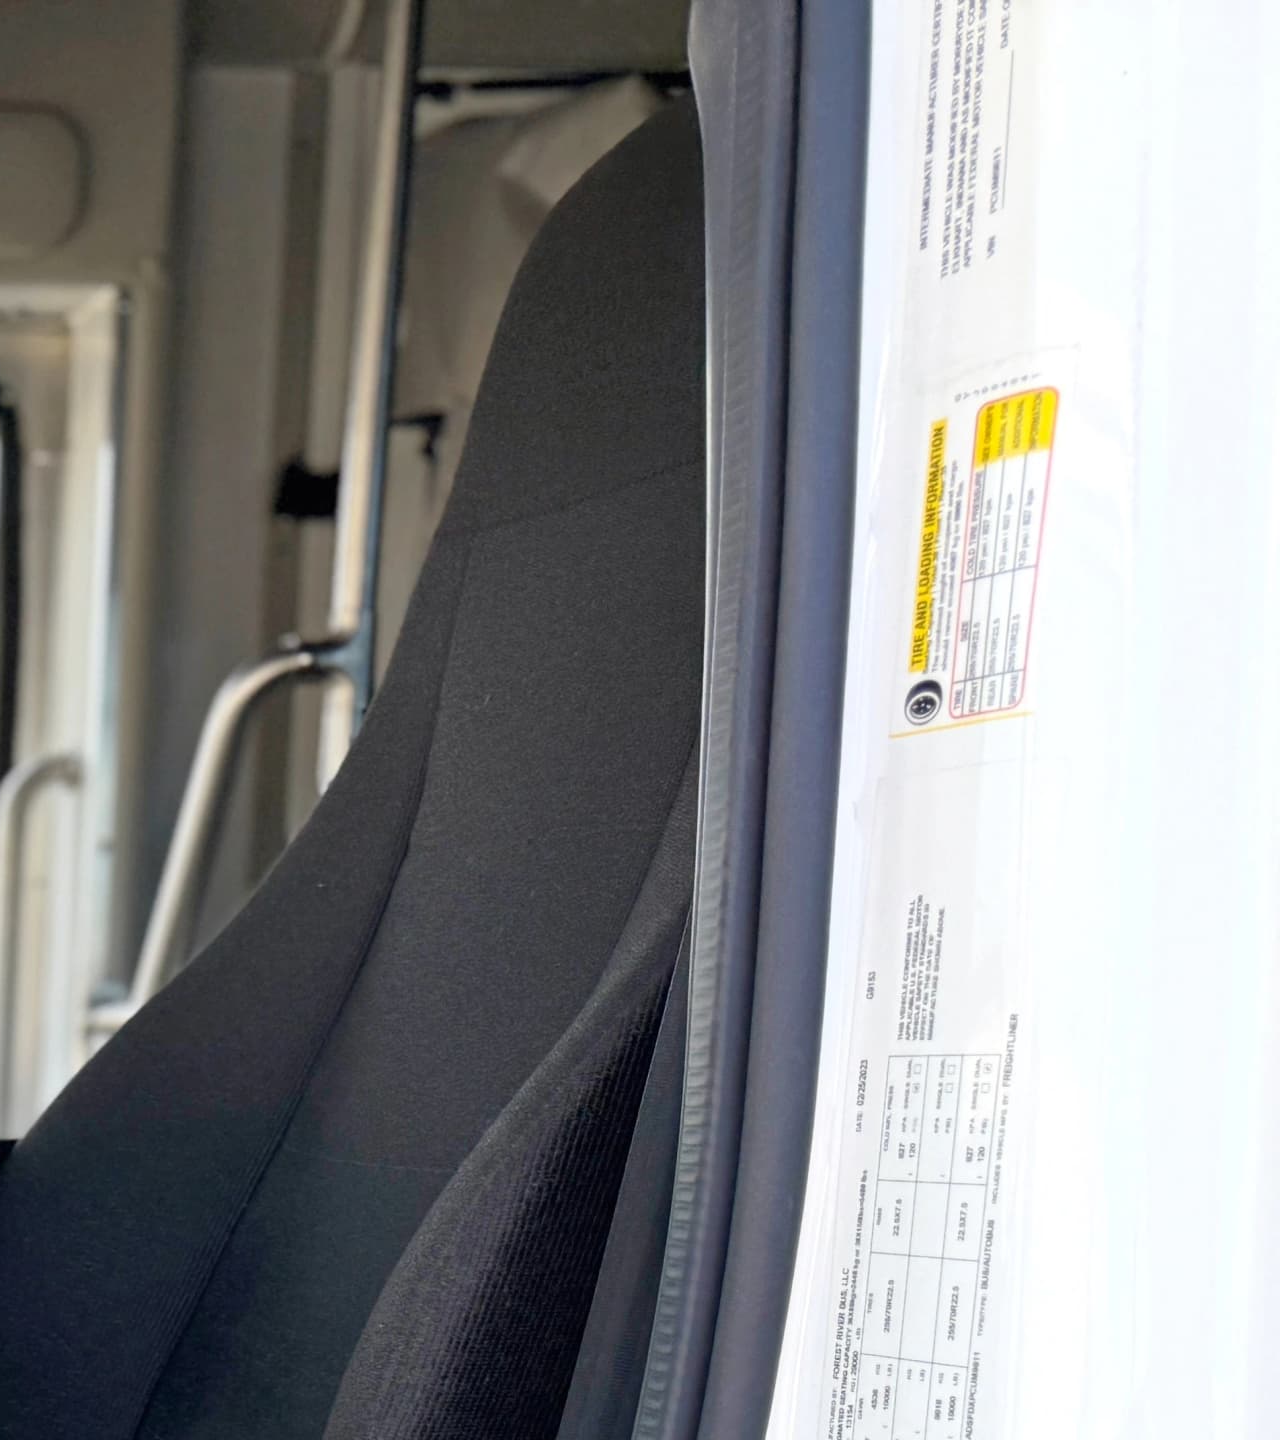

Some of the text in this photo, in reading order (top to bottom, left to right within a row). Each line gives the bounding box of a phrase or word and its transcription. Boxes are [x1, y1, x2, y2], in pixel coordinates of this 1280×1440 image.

[942, 195, 952, 247] VEHICLE
[924, 425, 944, 527] INFORMATION
[918, 531, 933, 596] LOADING
[914, 600, 927, 630] AND
[911, 634, 924, 666] TIRE
[899, 983, 908, 1020] VEHICLE
[856, 1059, 868, 1106] 02/25/2023
[980, 1219, 994, 1289] BUS/AUTOBUS
[1001, 1013, 1018, 1087] FREIGHTLINER
[841, 1267, 849, 1285] LLC
[839, 1288, 848, 1309] BUS,
[836, 1312, 845, 1340] RIVER
[832, 1343, 842, 1379] FOREST
[842, 1327, 852, 1367] CAPACITY
[839, 1369, 848, 1405] SEATING
[845, 1404, 853, 1429] 13154
